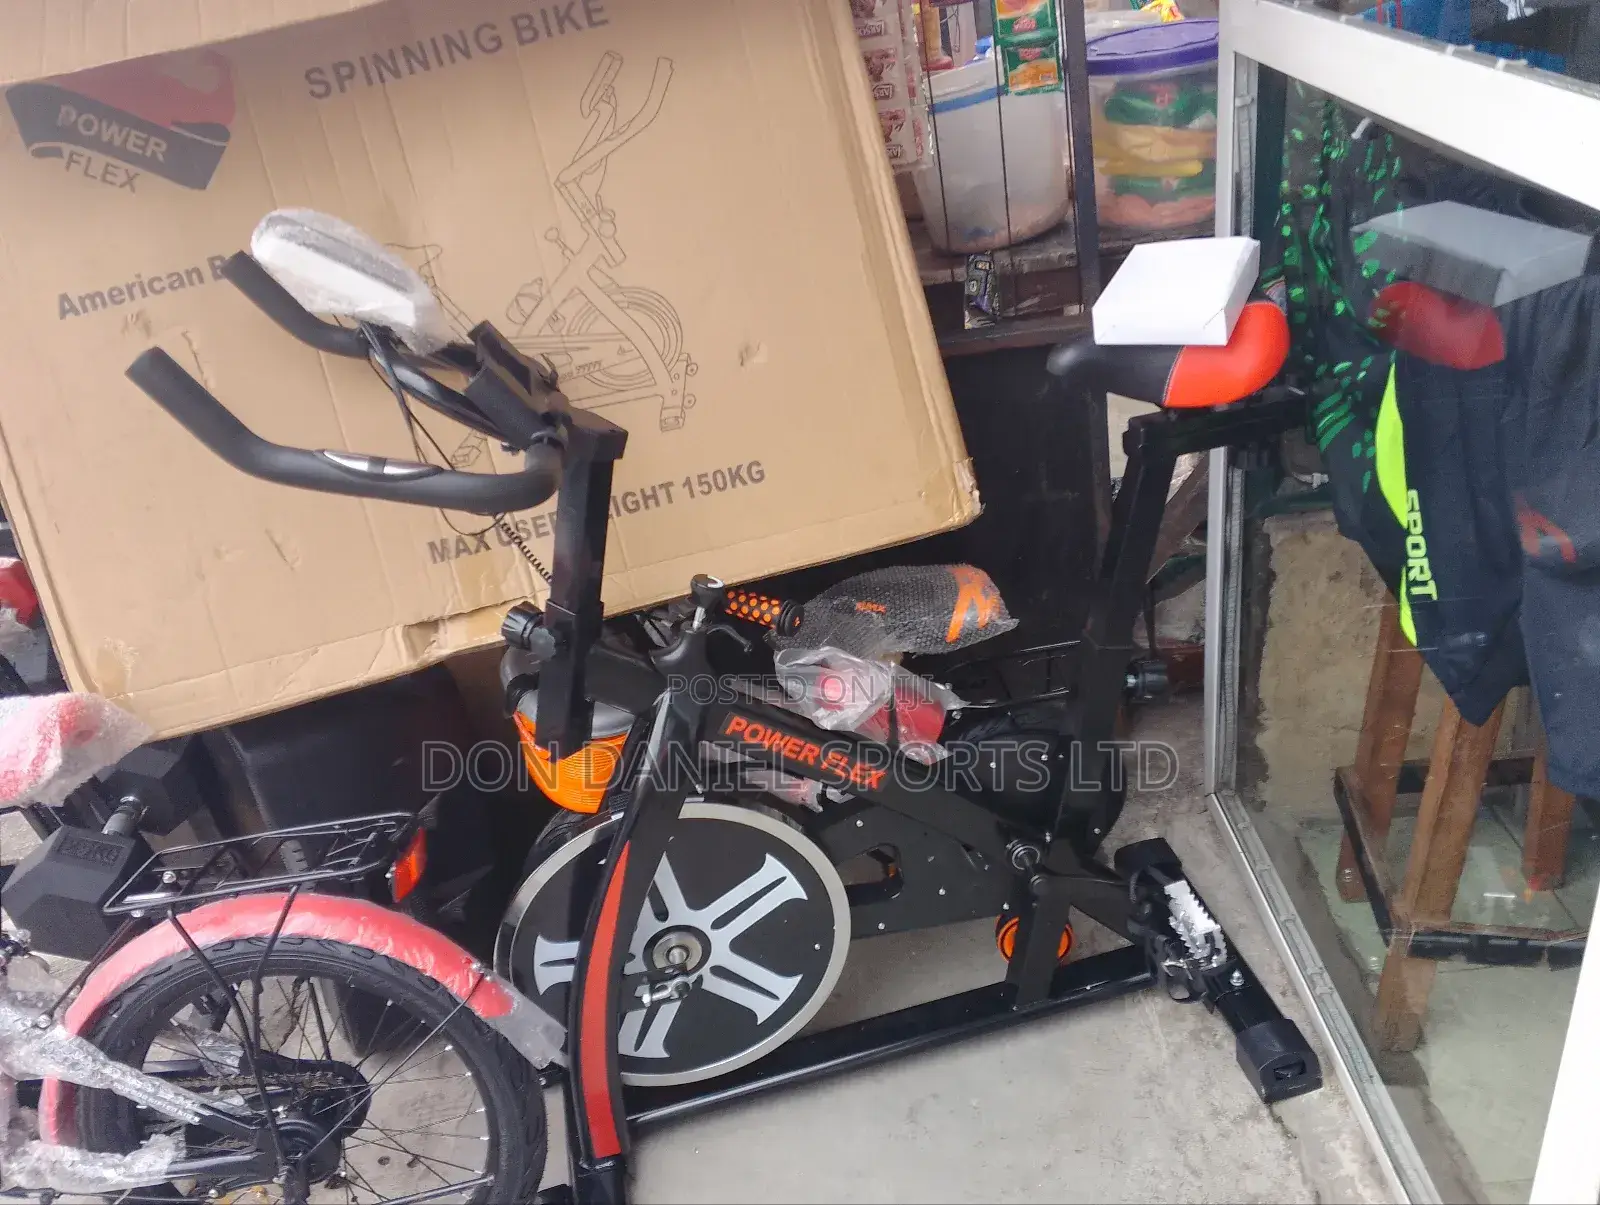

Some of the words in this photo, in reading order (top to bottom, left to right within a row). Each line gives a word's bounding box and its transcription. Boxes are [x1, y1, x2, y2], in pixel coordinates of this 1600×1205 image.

[304, 22, 503, 99] SPINNING
[510, 0, 609, 46] BIKE
[56, 104, 167, 163] POWER
[65, 150, 140, 193] FLEX
[58, 266, 205, 320] American
[427, 530, 491, 564] MAX
[608, 481, 675, 519] IGHT
[682, 460, 765, 499] 150KG
[1406, 489, 1438, 601] SPORT
[725, 716, 821, 766] POWER
[820, 750, 887, 789] FLEX
